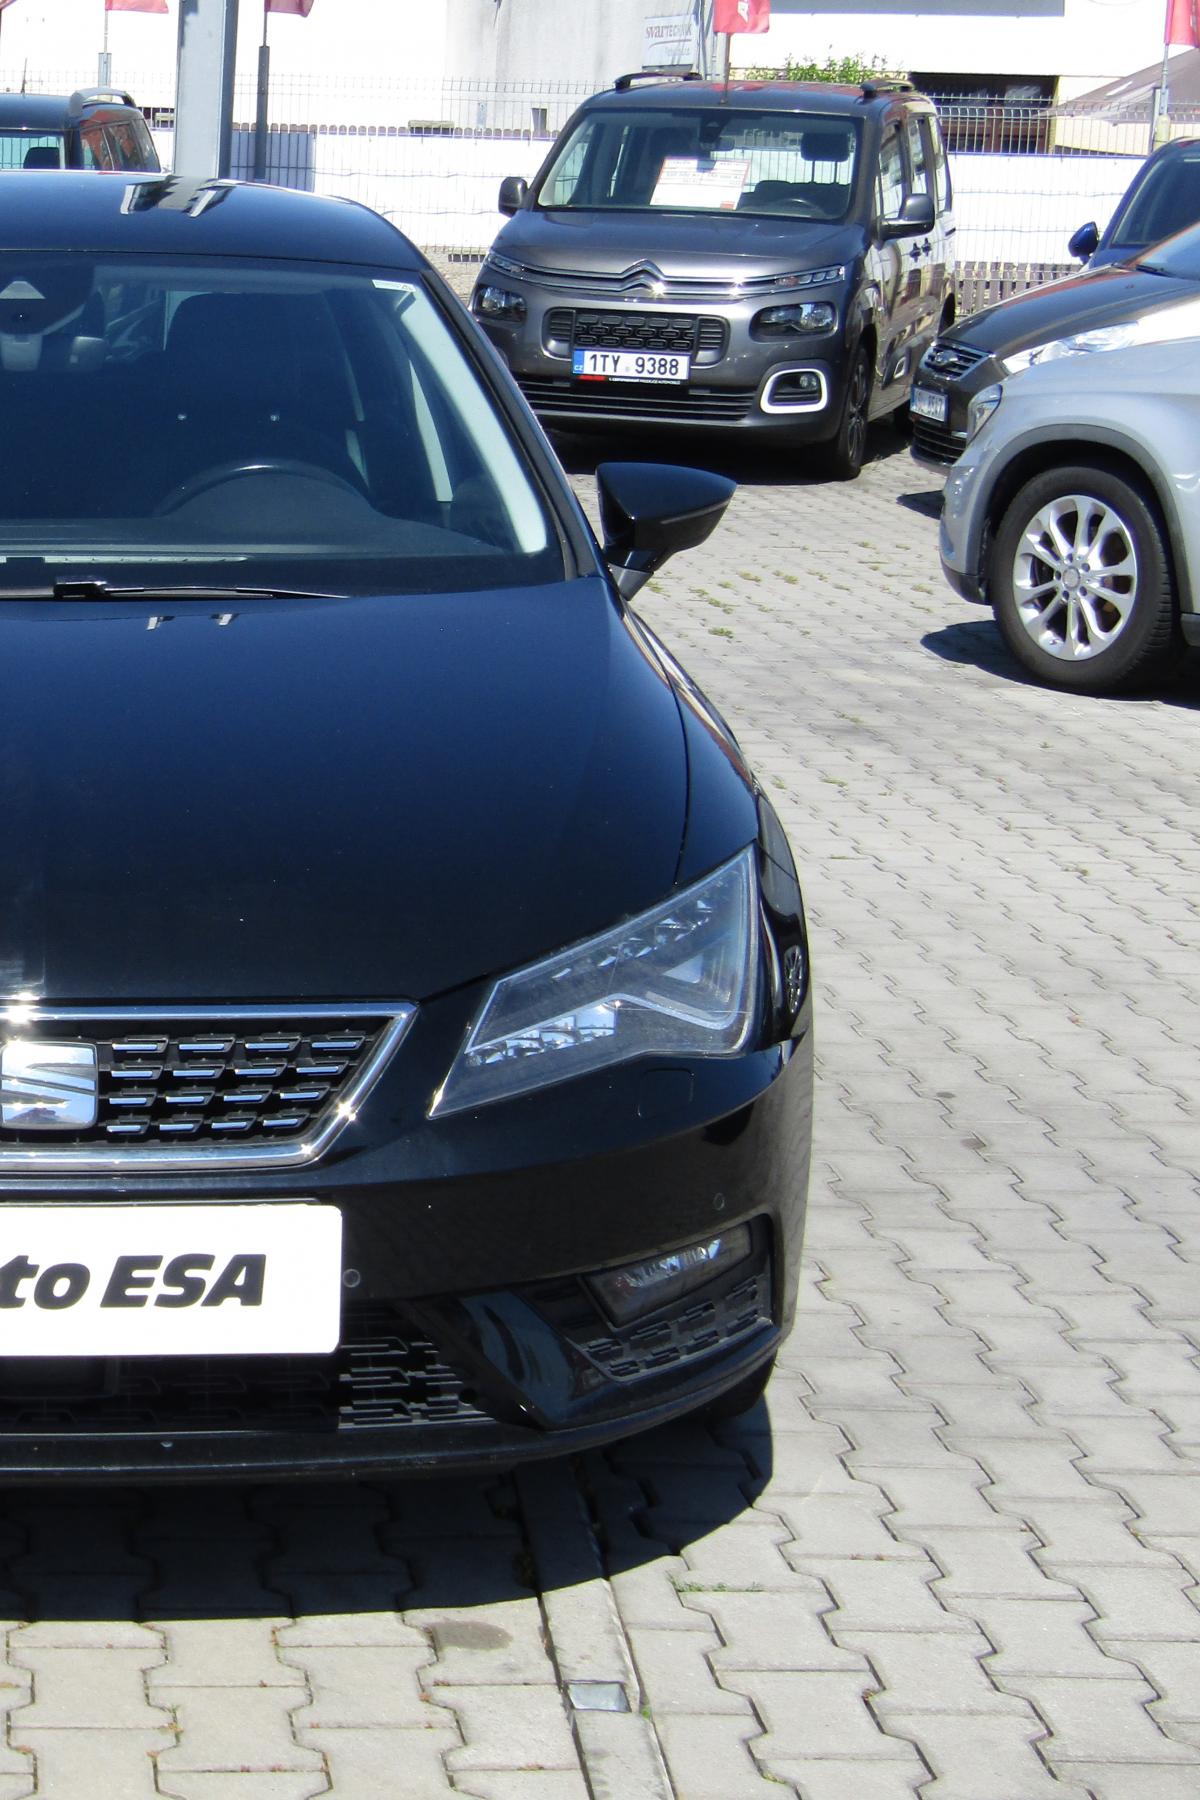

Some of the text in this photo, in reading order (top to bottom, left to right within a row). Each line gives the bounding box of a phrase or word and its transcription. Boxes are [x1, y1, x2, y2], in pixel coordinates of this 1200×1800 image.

[590, 353, 679, 376] 1TY 9388
[100, 1253, 267, 1309] ESA
